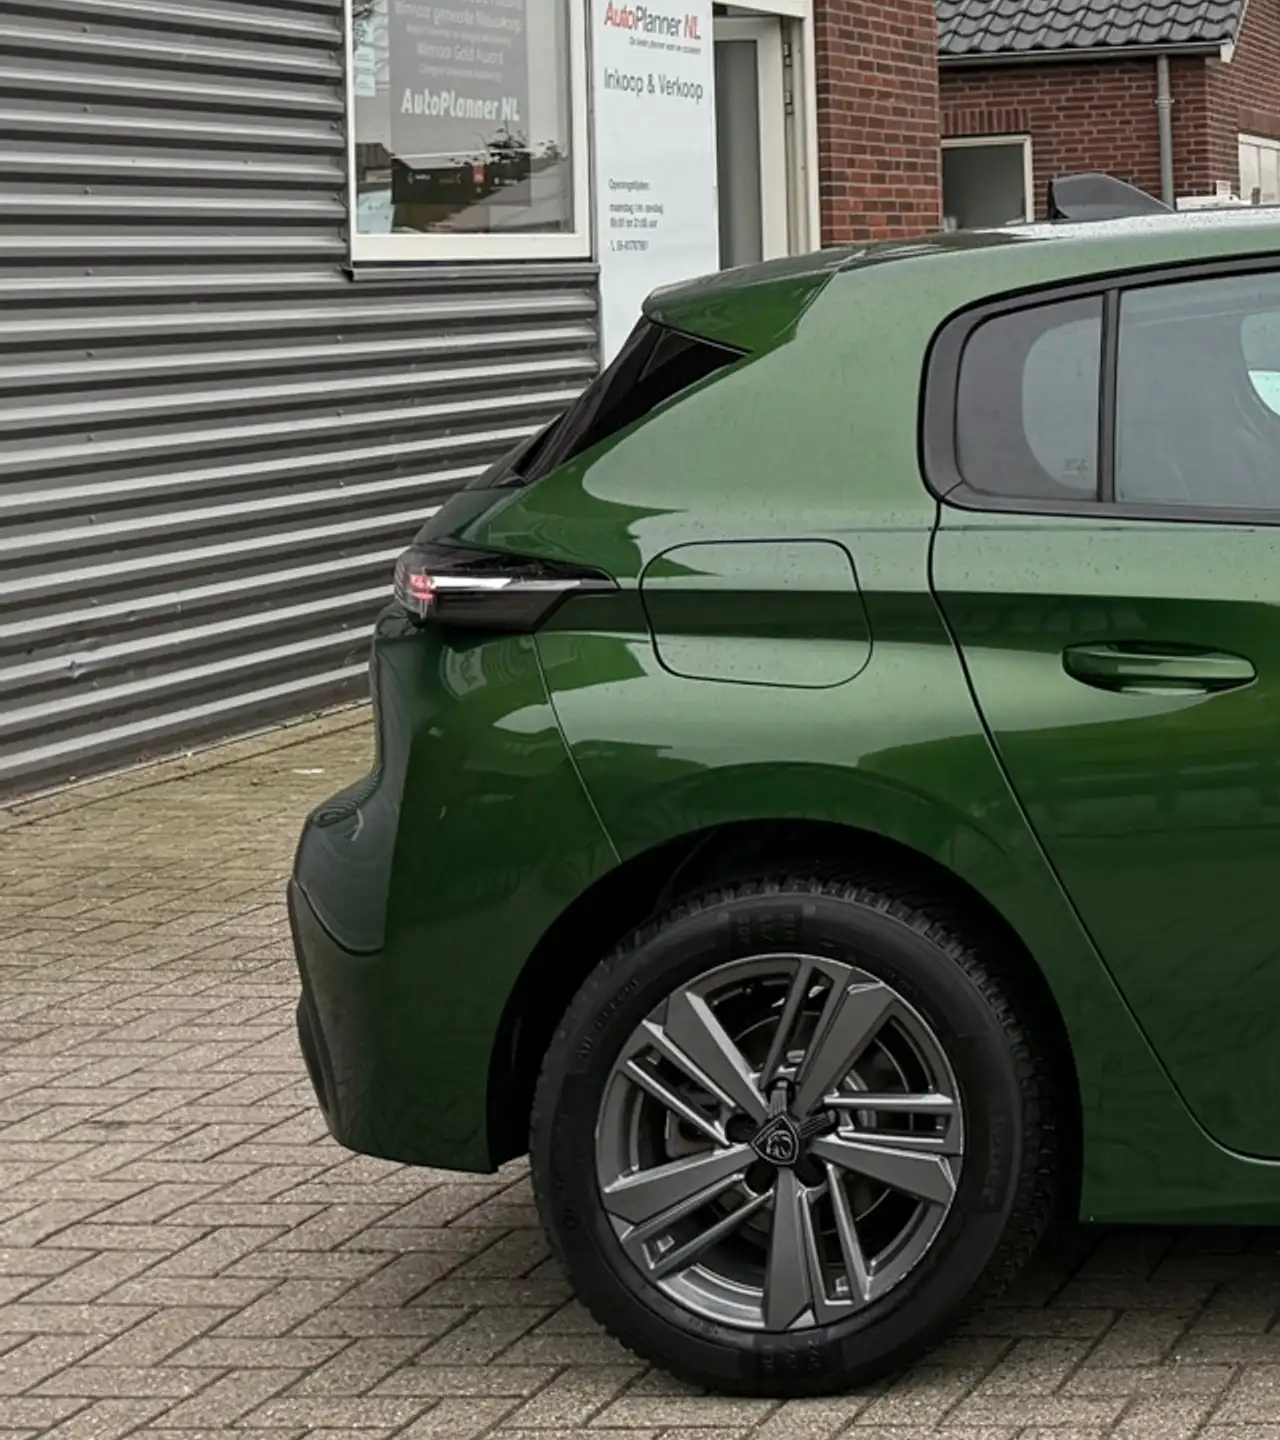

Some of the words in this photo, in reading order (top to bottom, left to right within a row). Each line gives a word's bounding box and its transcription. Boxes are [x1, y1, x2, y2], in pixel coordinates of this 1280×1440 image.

[604, 0, 682, 37] AutoPlanner
[683, 13, 701, 41] NL
[401, 87, 499, 121] AutoPlanner
[501, 96, 520, 122] NL
[604, 67, 644, 98] Inkoop
[646, 73, 656, 95] &
[657, 74, 703, 105] Verkoop
